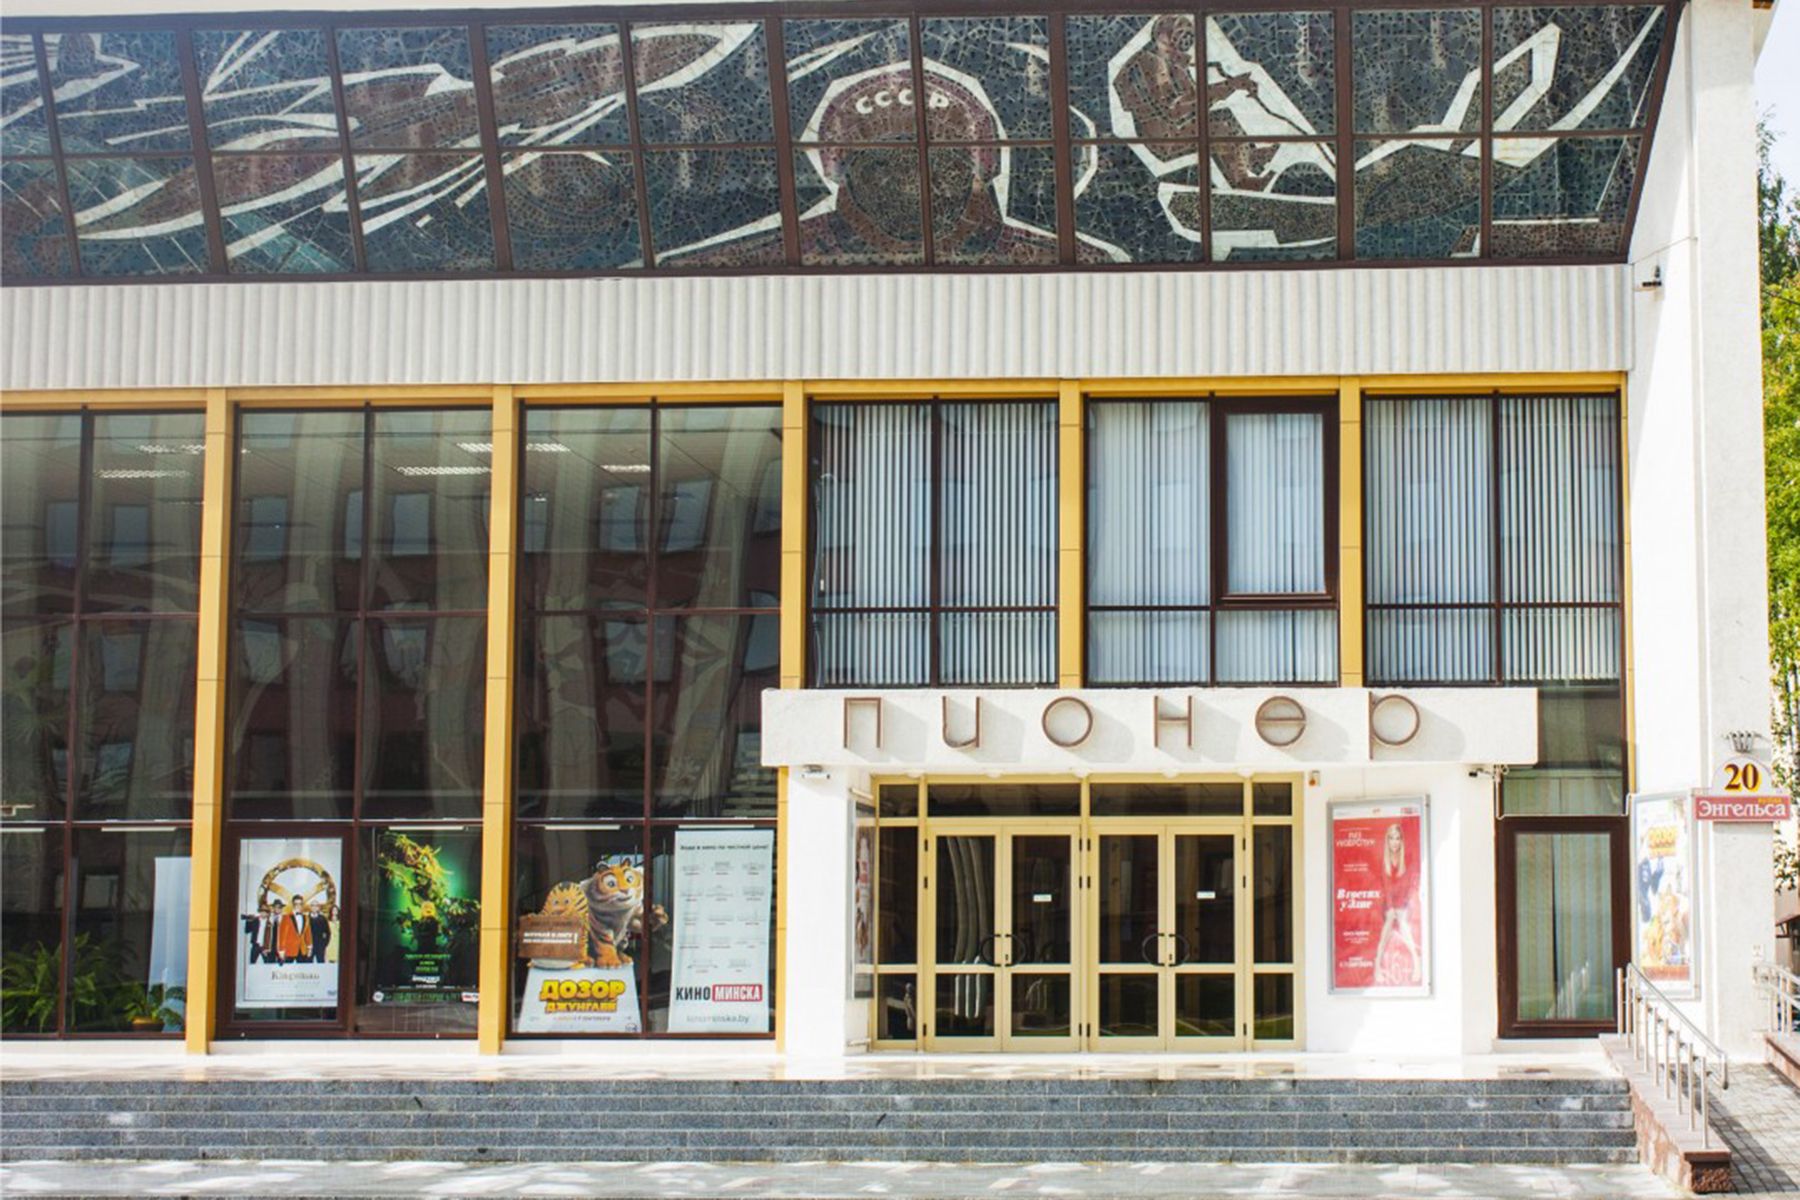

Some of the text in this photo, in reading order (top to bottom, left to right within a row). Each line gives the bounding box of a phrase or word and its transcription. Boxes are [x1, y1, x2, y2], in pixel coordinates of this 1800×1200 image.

[855, 89, 950, 114] СССР
[1723, 763, 1762, 792] 20
[1698, 800, 1786, 817] Энгельса
[539, 979, 626, 1001] ДОЗОР
[676, 985, 761, 1001] КИНО МИНСКА
